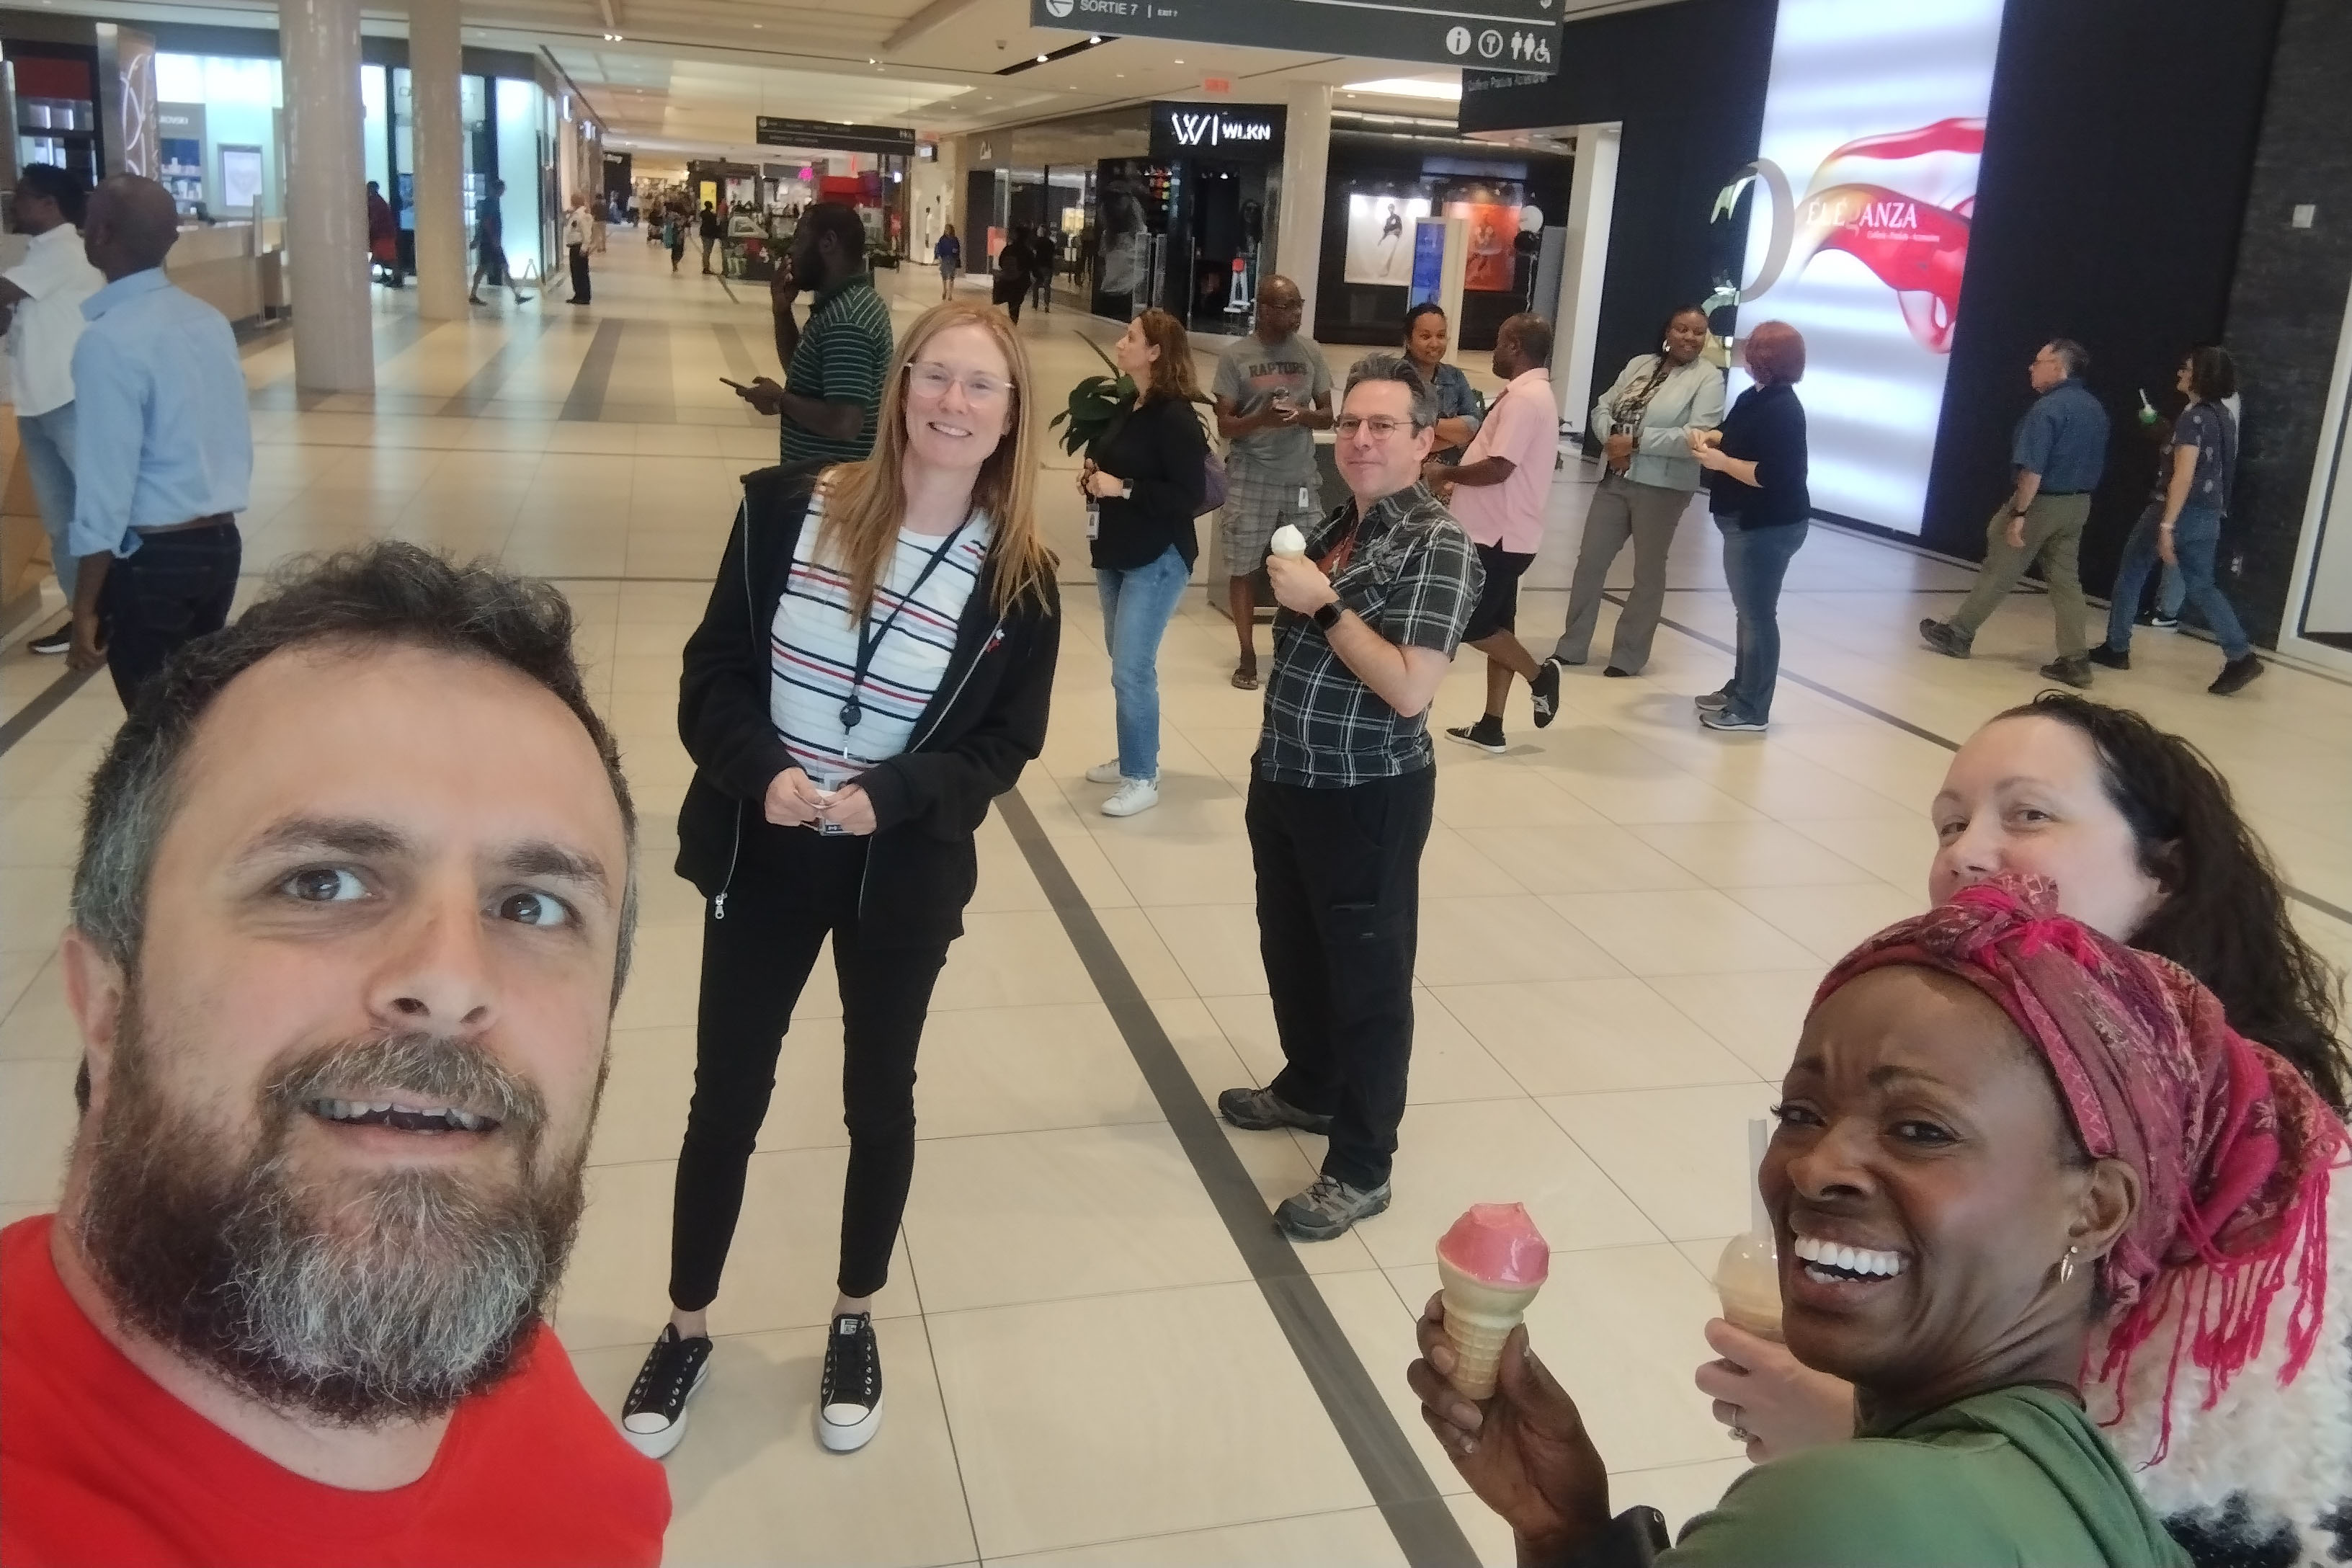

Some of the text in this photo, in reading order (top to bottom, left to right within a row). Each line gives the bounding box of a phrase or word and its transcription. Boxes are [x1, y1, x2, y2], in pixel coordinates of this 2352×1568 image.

[1080, 0, 1139, 16] SORTIE 7
[1222, 122, 1270, 141] WLKN
